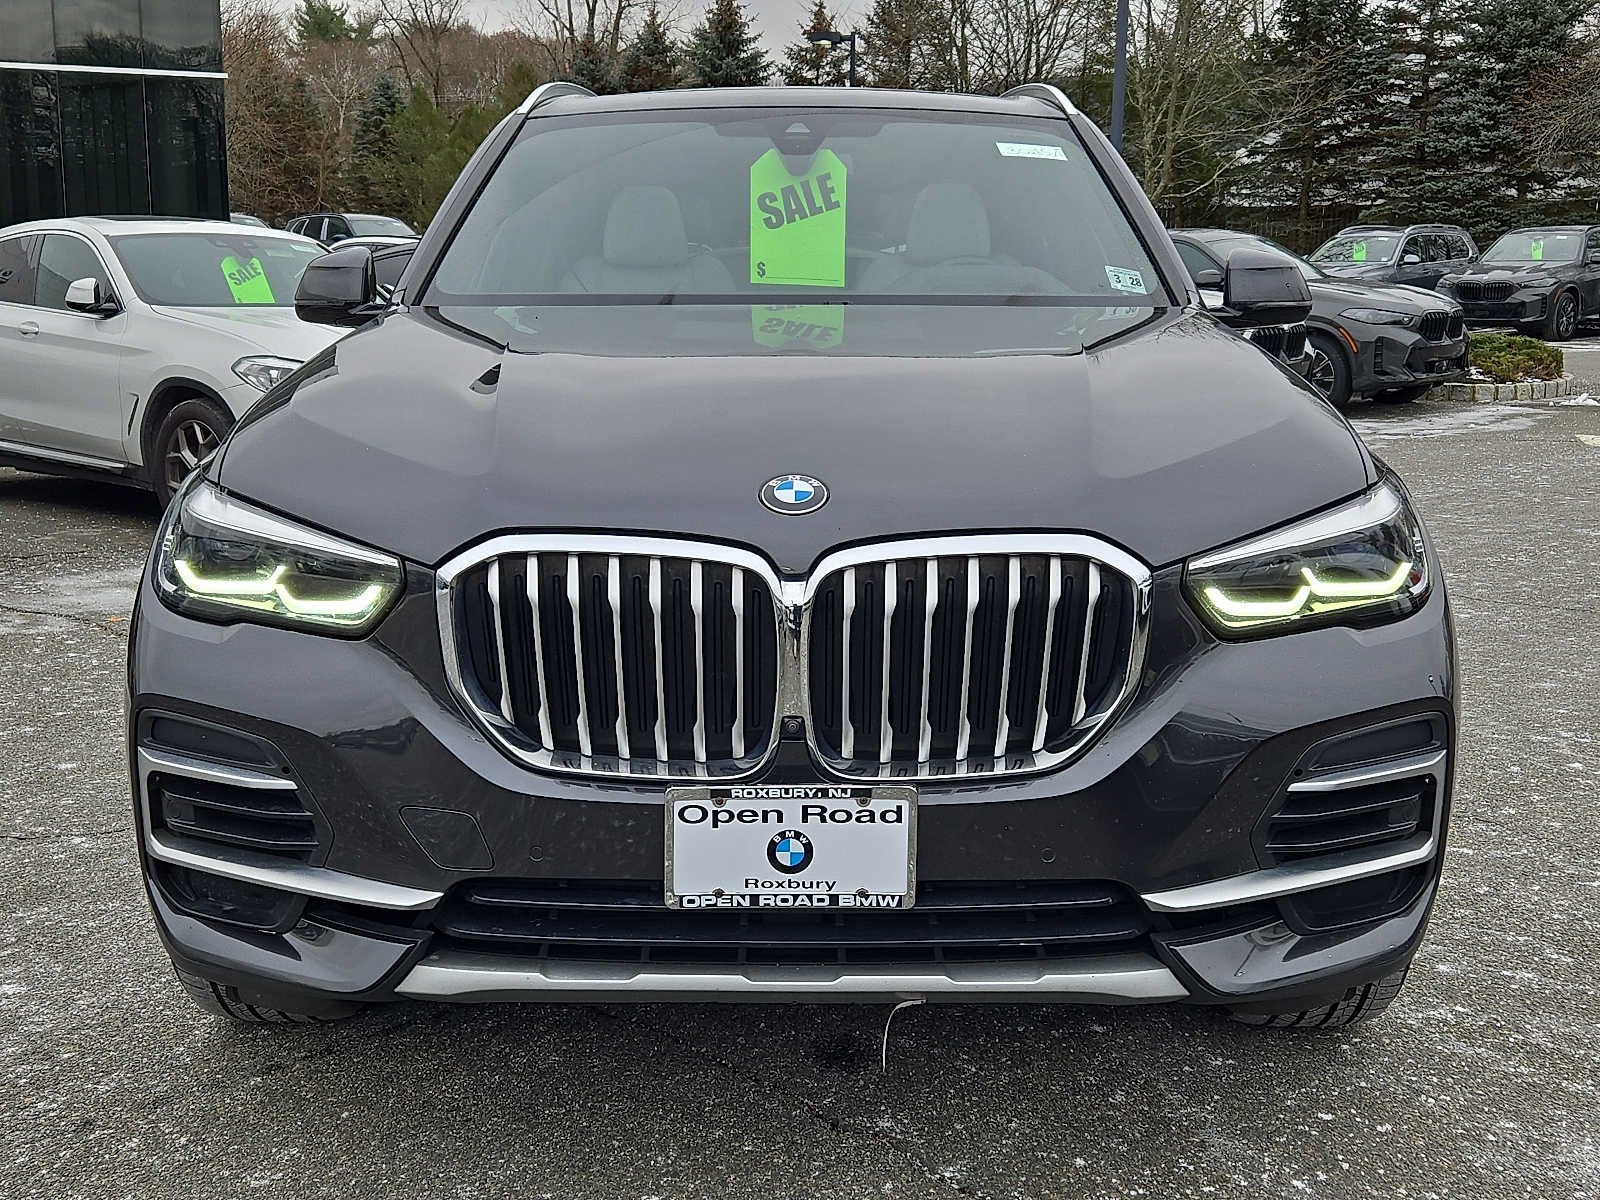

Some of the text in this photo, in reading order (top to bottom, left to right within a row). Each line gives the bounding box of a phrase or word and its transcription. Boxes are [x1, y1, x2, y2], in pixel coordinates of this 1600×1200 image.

[757, 172, 840, 230] SALE
[228, 262, 261, 286] SALE
[757, 261, 766, 278] $
[1113, 274, 1142, 287] 3 28
[829, 788, 851, 798] NJ
[677, 804, 904, 828] Open Road
[773, 830, 809, 844] BMW
[744, 878, 837, 892] Roxbury
[682, 895, 900, 908] OPEN ROAD BMW
